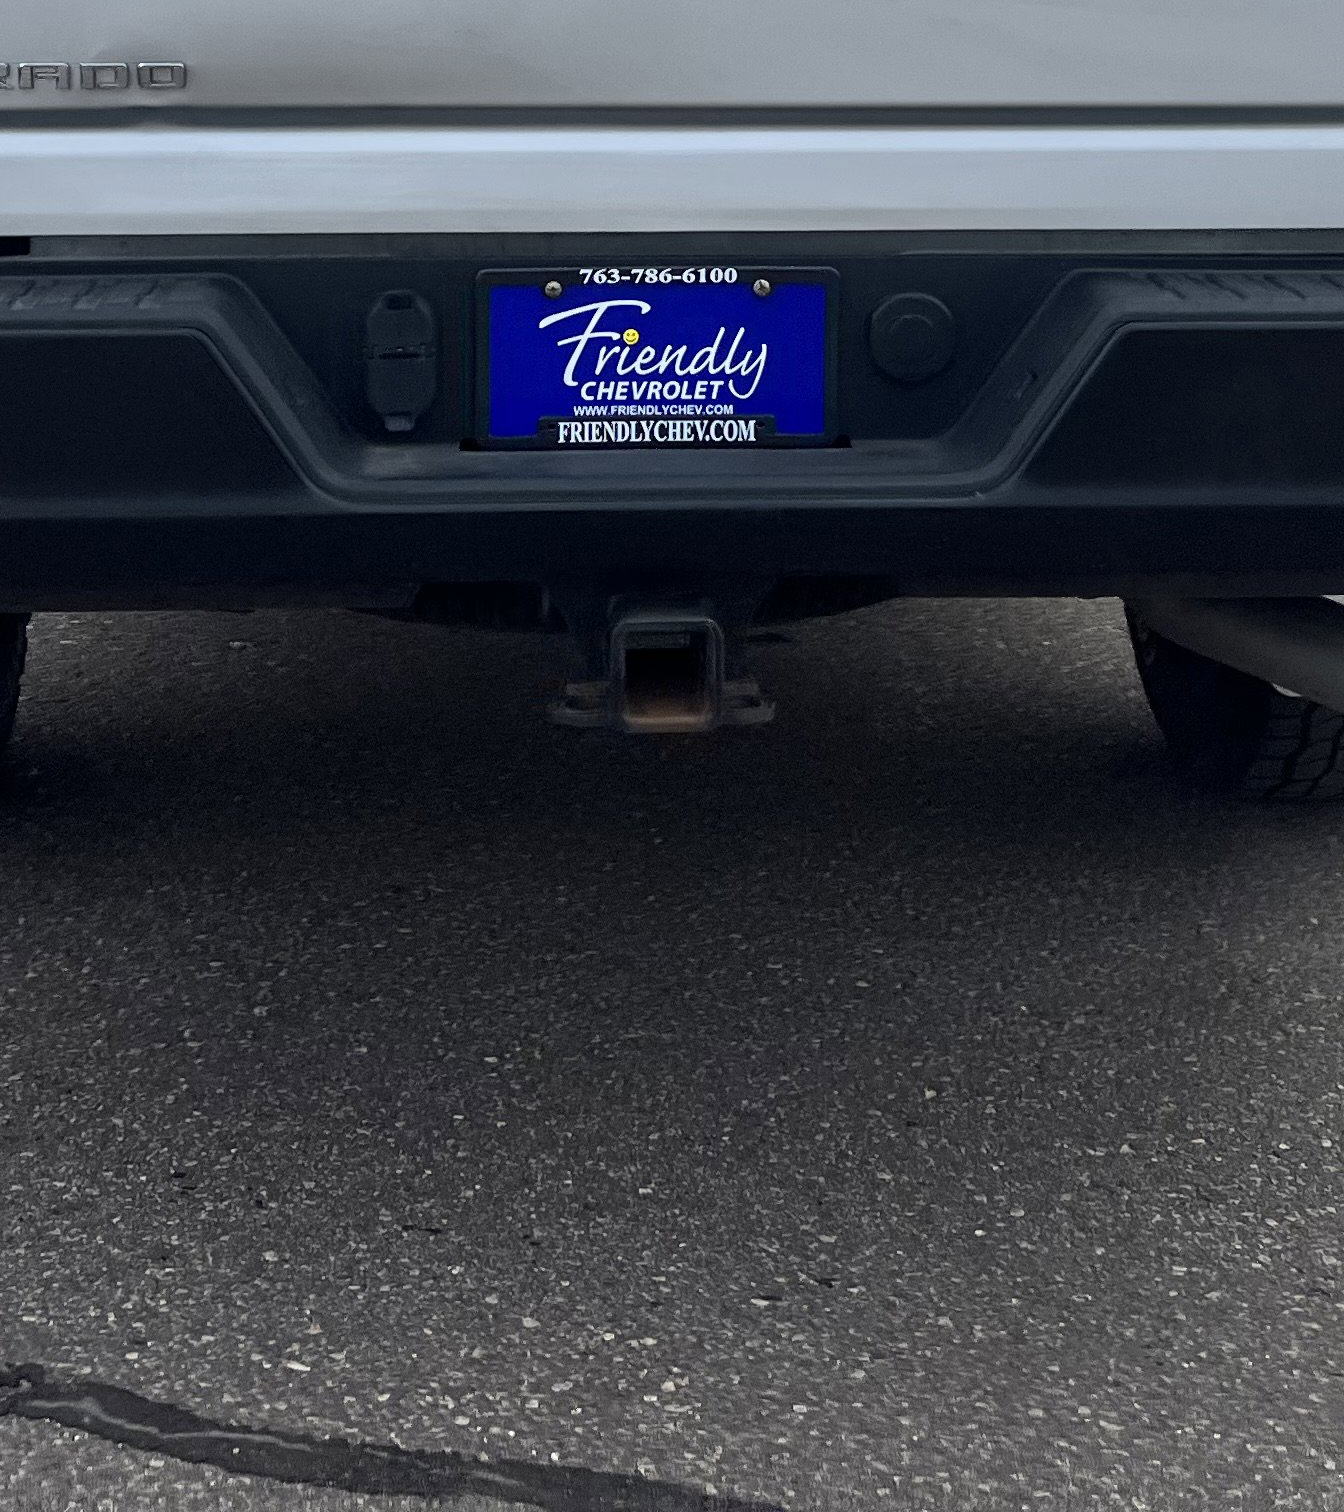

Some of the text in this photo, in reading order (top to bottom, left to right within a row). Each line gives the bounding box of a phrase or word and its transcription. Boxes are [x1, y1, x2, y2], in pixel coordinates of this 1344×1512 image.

[579, 267, 738, 284] 763-786-6100
[539, 299, 768, 399] Friendly
[580, 379, 725, 401] CHEVROLET
[573, 404, 734, 416] WWW.FRIENDLYCHEV.COM
[557, 419, 757, 443] FRIENDLYCHEV.COM
